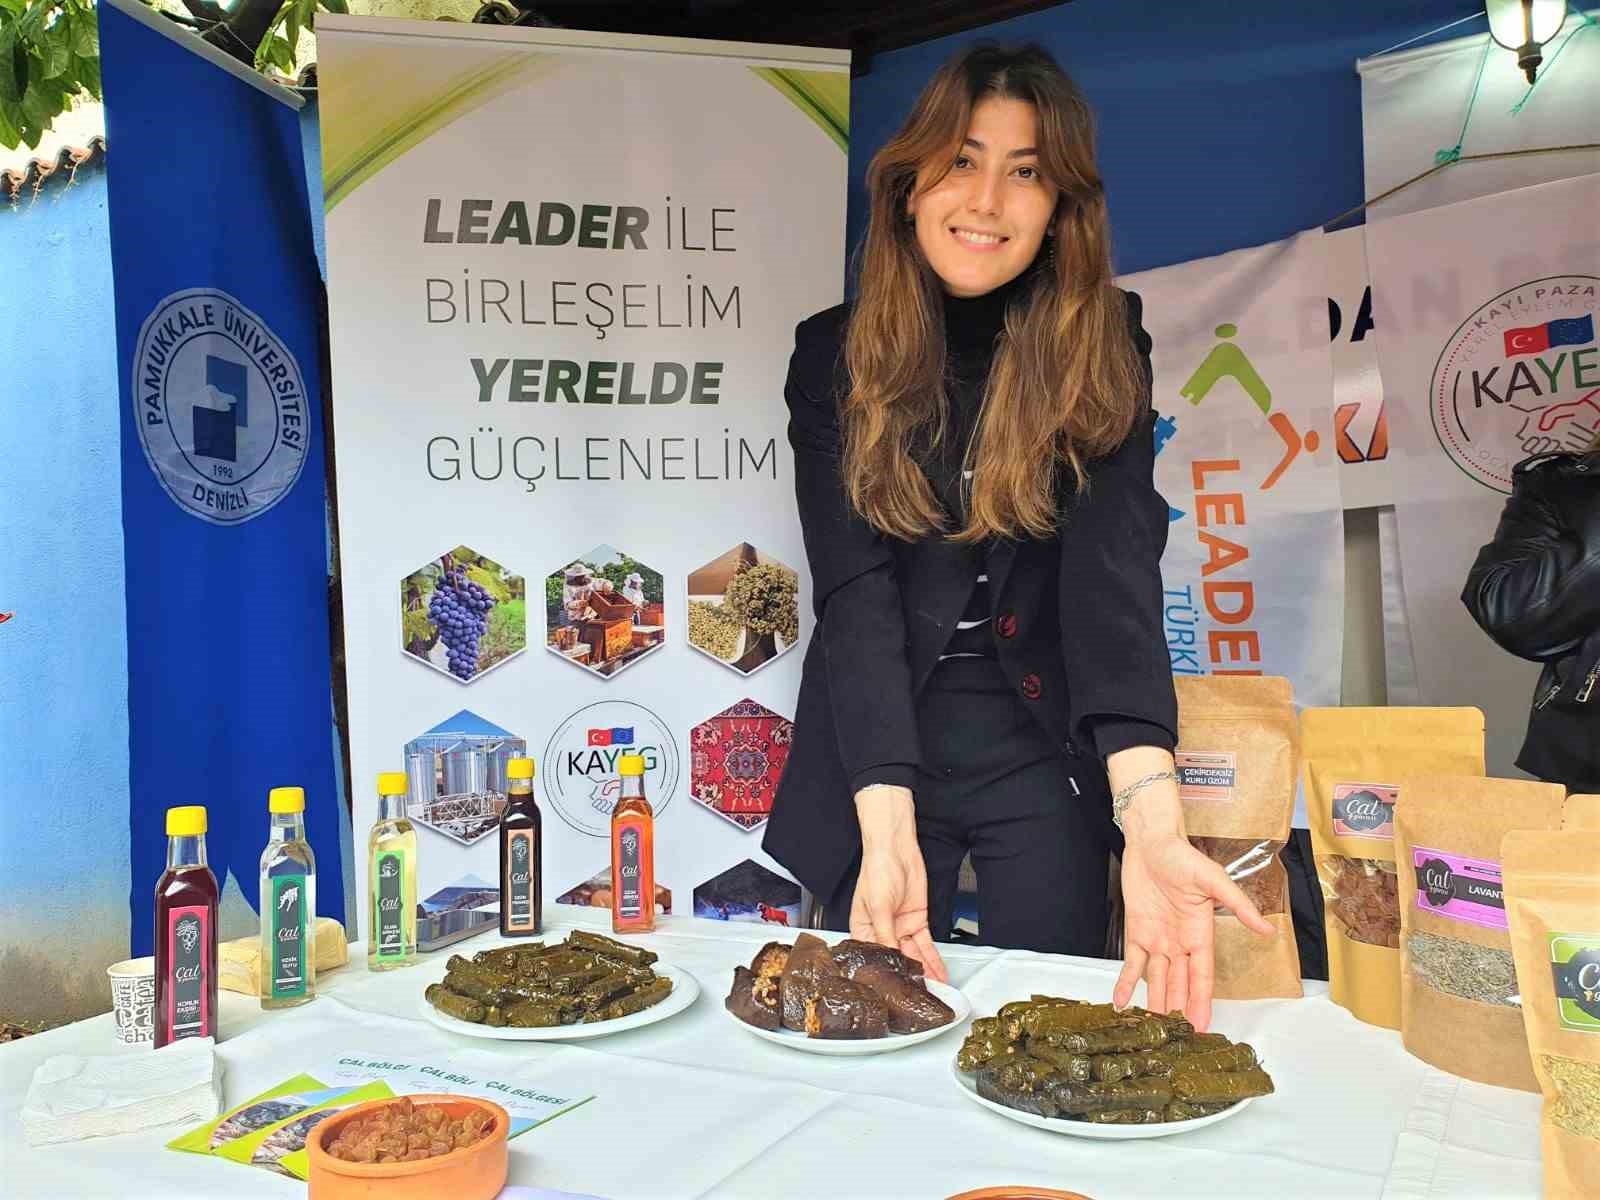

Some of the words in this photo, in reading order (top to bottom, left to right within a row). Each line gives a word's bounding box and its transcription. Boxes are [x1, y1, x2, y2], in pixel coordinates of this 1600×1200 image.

[423, 198, 650, 250] LEADER
[665, 195, 737, 252] İLE
[425, 268, 742, 340] BİRLEŞELİM
[143, 303, 216, 426] PAMUKKALE
[470, 358, 724, 405] YERELDE
[1472, 347, 1600, 408] KAYE
[212, 464, 233, 479] 1992
[426, 427, 777, 493] GÜÇLENELİM
[1191, 459, 1264, 677] LEADE
[568, 746, 657, 776] KAYG
